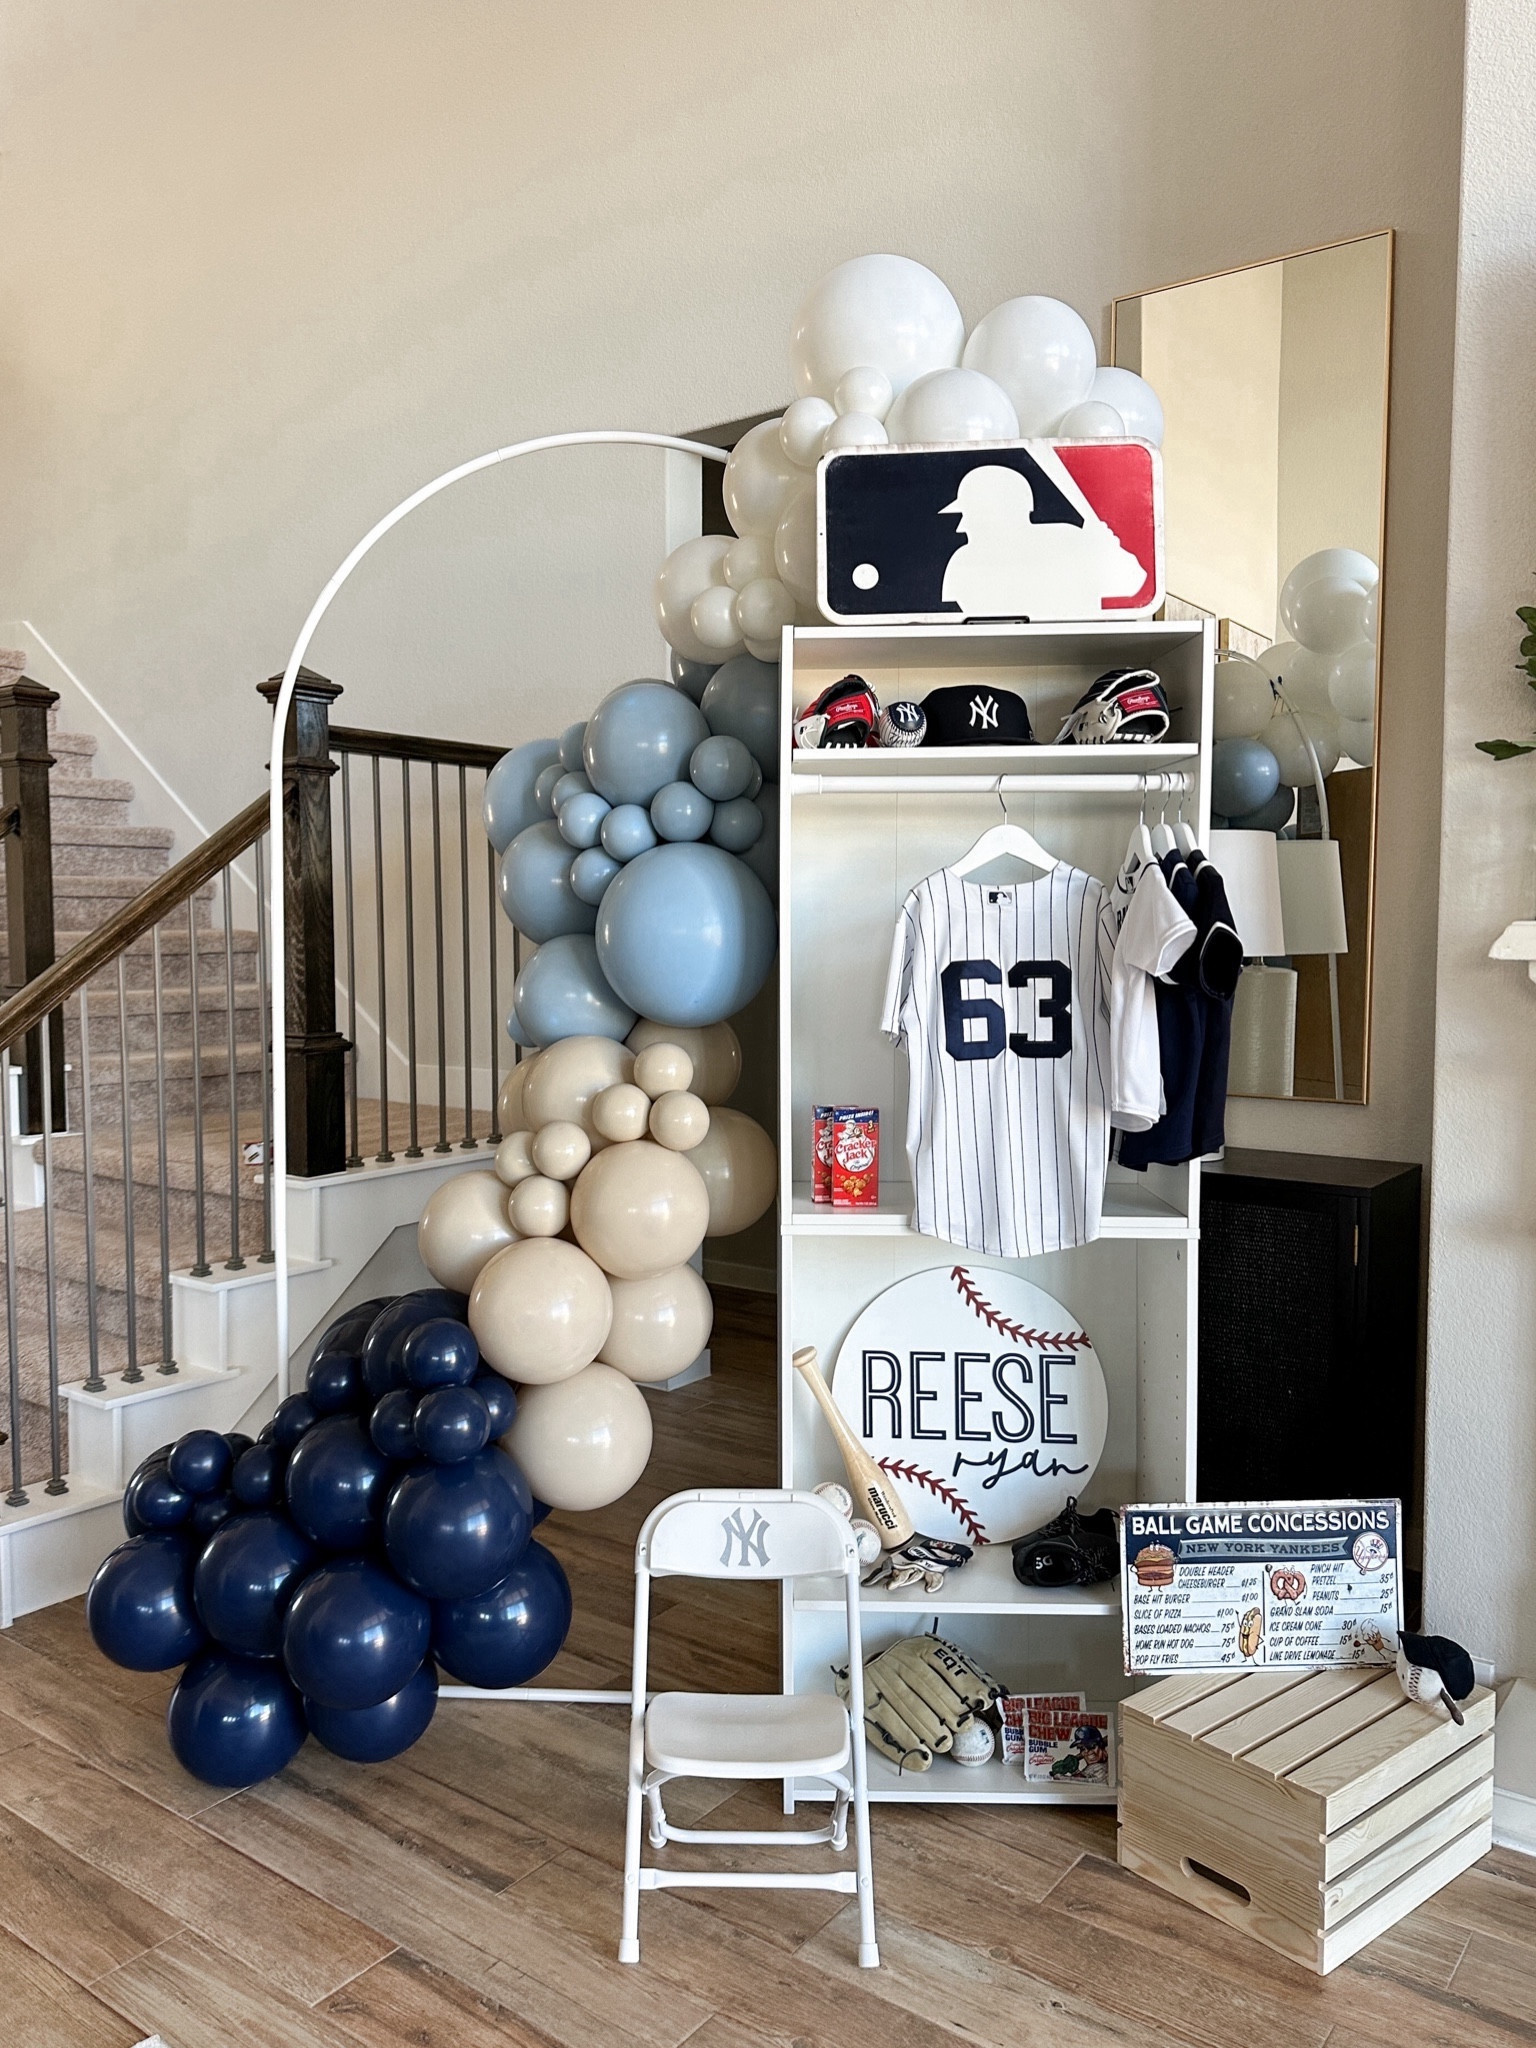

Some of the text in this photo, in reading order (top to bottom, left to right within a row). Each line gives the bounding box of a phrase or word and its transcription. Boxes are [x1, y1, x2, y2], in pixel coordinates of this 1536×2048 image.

[896, 703, 920, 723] NY
[969, 694, 999, 729] NY
[941, 959, 1073, 1061] 63
[836, 1139, 877, 1154] Cracker
[843, 1149, 868, 1163] Jack
[862, 1350, 1078, 1444] REESE
[952, 1448, 1089, 1489] ryan
[868, 1487, 898, 1530] marucci
[1132, 1510, 1390, 1535] BALL GAME CONCESSIONS
[719, 1507, 771, 1568] NY
[1186, 1543, 1340, 1554] NEW YORK YANKEES
[1179, 1566, 1235, 1577] DOUBLE HEADER
[1310, 1563, 1345, 1574] PINCH HIT
[1178, 1579, 1226, 1588] CHEESEBURGER
[1312, 1576, 1337, 1585] PRETZEL
[1134, 1594, 1150, 1605] BASE
[1152, 1594, 1162, 1604] HIT
[1164, 1594, 1191, 1604] BURGER
[1312, 1590, 1340, 1601] PEANUTS
[1134, 1609, 1151, 1619] SLICE
[1152, 1609, 1163, 1619] OF
[1164, 1609, 1182, 1619] PIZZA
[1270, 1606, 1293, 1617] GRAND
[1295, 1606, 1314, 1616] SLAM
[1315, 1605, 1334, 1615] SODA
[1134, 1624, 1156, 1634] BASES
[1156, 1624, 1182, 1634] LOADED
[1183, 1623, 1212, 1633] NACHOS
[1269, 1621, 1279, 1631] ICE
[1281, 1621, 1304, 1631] CREAM
[1305, 1621, 1323, 1630] CONE
[1135, 1639, 1152, 1650] HOME
[1153, 1639, 1165, 1649] RUN
[1166, 1639, 1179, 1649] HOT
[1180, 1638, 1194, 1649] DOG
[1269, 1637, 1283, 1647] CUP
[1284, 1637, 1295, 1646] OF
[1295, 1636, 1320, 1646] COFFEE
[1135, 1655, 1149, 1665] POP
[1150, 1654, 1161, 1665] FLY
[1162, 1654, 1179, 1664] FRIES
[1269, 1651, 1283, 1661] LINE
[1284, 1650, 1303, 1660] DRIVE
[1303, 1650, 1336, 1660] LEMONADE
[1002, 1696, 1081, 1712] BIG LEAGUE
[1005, 1713, 1024, 1728] CH
[1028, 1710, 1108, 1729] BIG LEAGUE
[1004, 1727, 1024, 1736] BUBB
[1028, 1725, 1072, 1741] CHEW
[1029, 1739, 1058, 1748] BUBBLE
